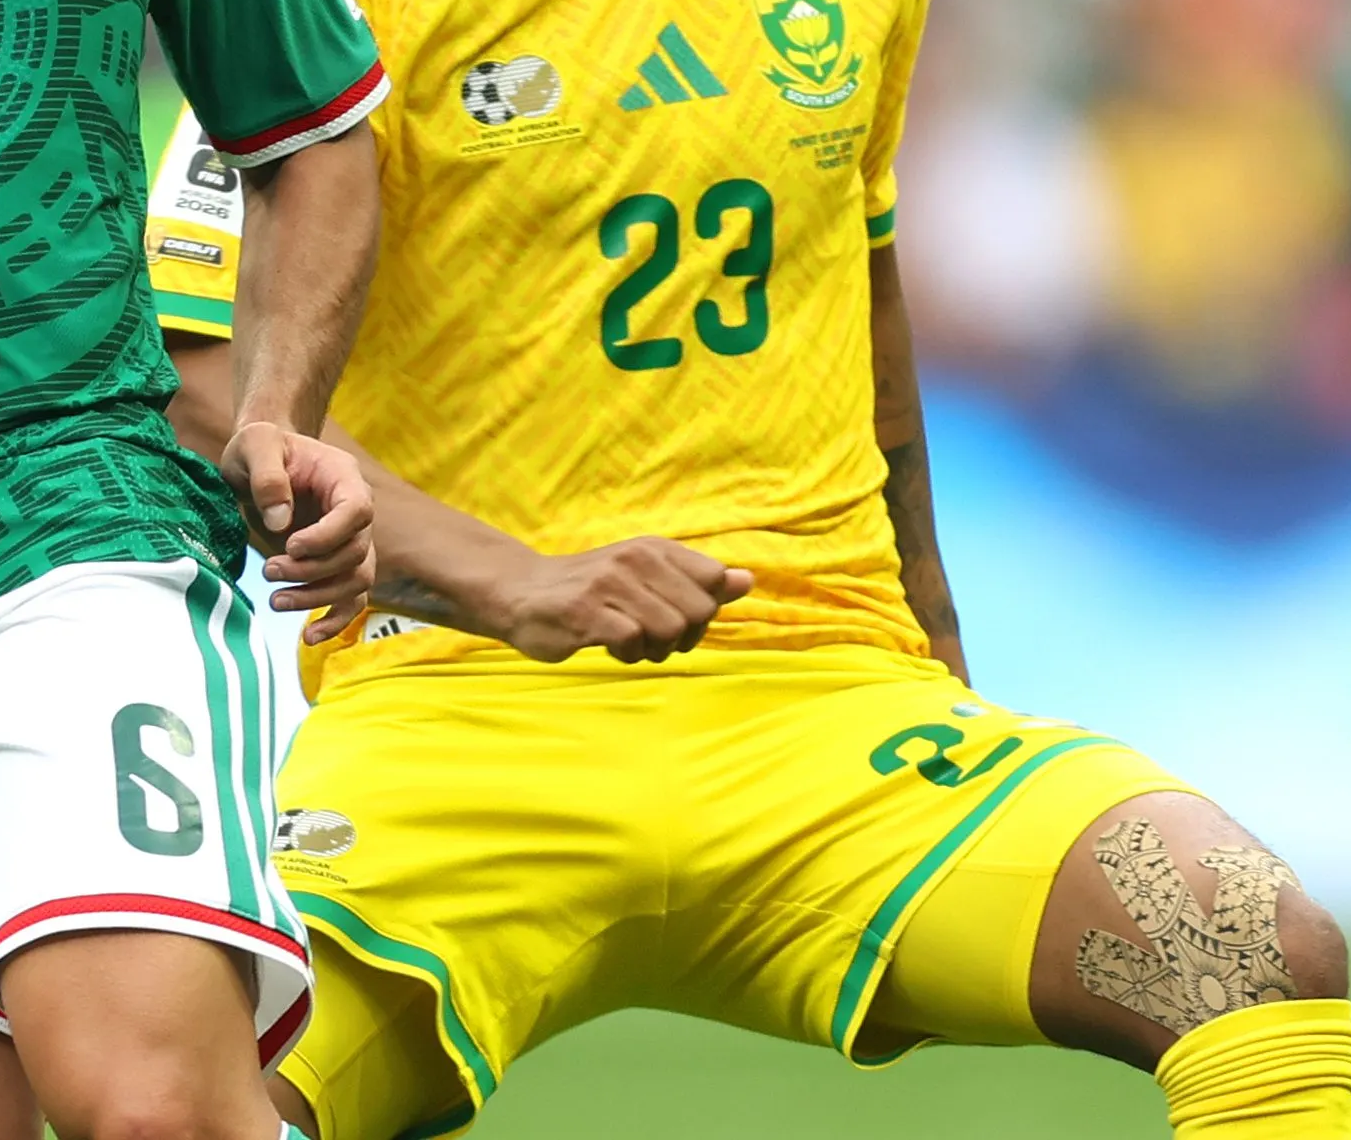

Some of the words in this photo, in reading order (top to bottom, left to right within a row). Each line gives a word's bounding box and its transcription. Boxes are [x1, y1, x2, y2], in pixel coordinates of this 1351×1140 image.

[196, 170, 226, 186] FIFA
[174, 197, 231, 219] 2026
[598, 178, 774, 371] 23
[111, 702, 204, 857] 6
[288, 856, 330, 869] AFRICAN
[281, 865, 348, 884] ASSOCIATION
